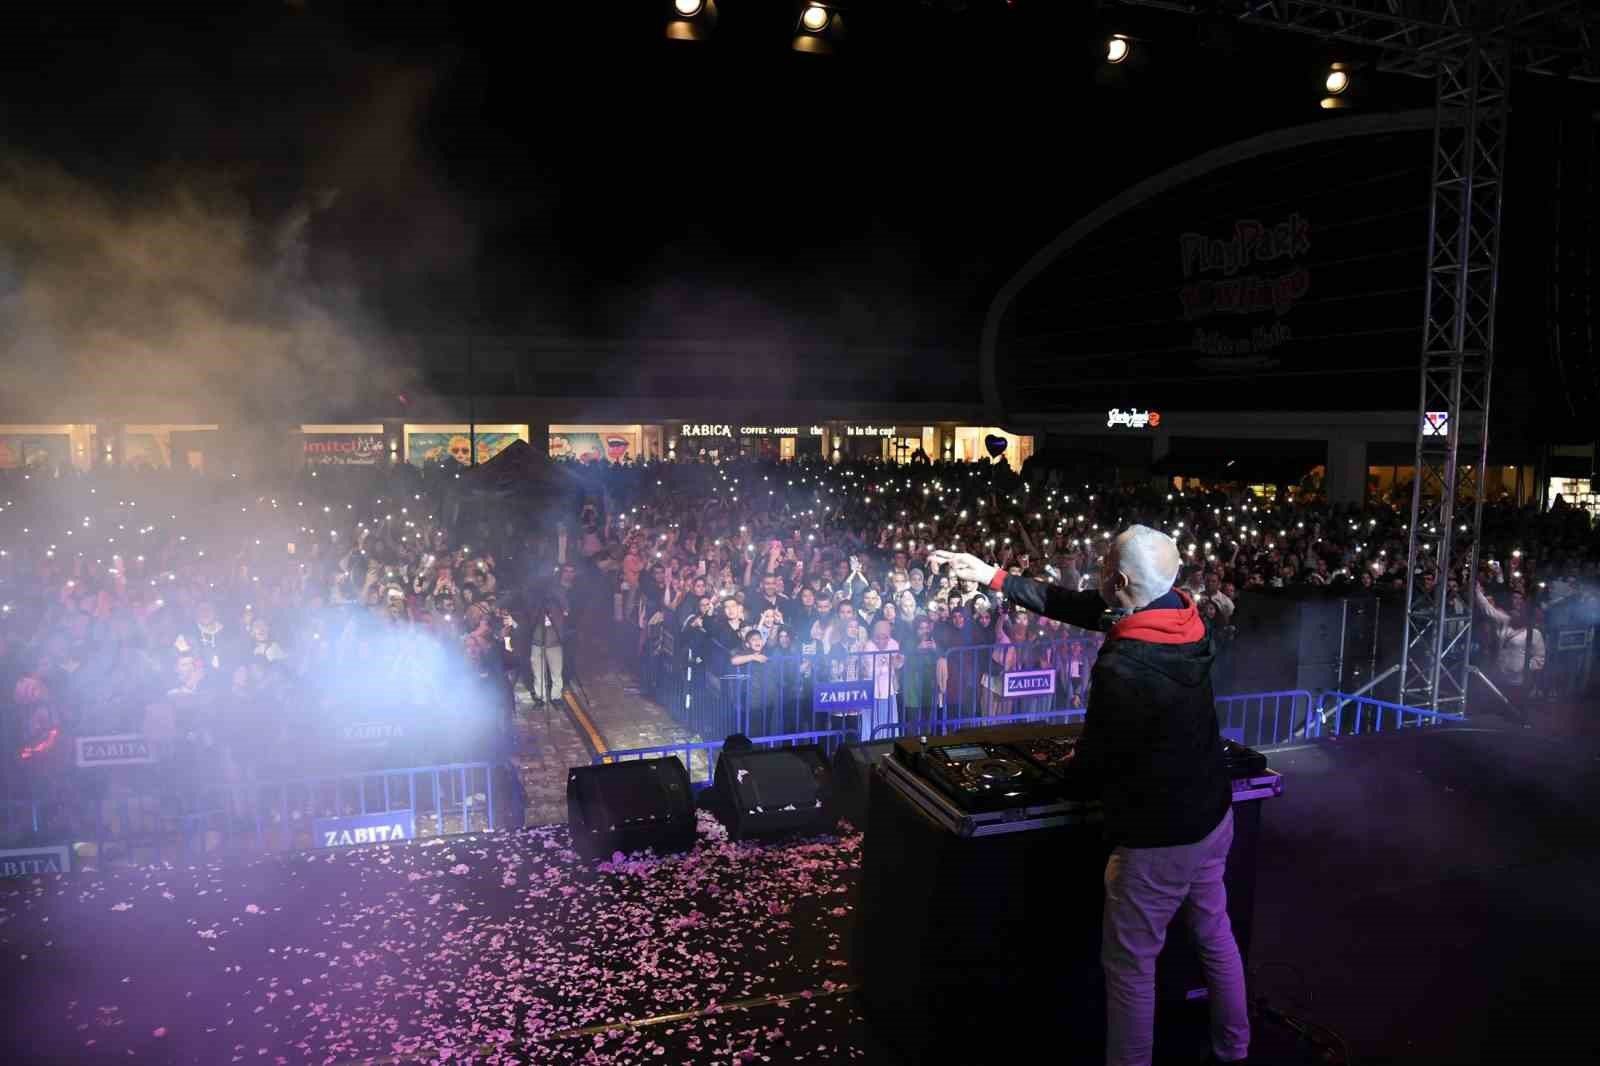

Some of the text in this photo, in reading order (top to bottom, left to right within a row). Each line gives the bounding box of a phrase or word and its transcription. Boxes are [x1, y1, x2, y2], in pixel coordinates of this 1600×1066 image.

[740, 427, 798, 435] COFFEE HOUSE
[810, 425, 824, 436] the
[865, 425, 878, 436] the
[1008, 676, 1050, 690] ZABITA
[820, 689, 868, 704] ZABITA
[324, 824, 404, 847] ZABITA
[0, 858, 59, 877] BITA
